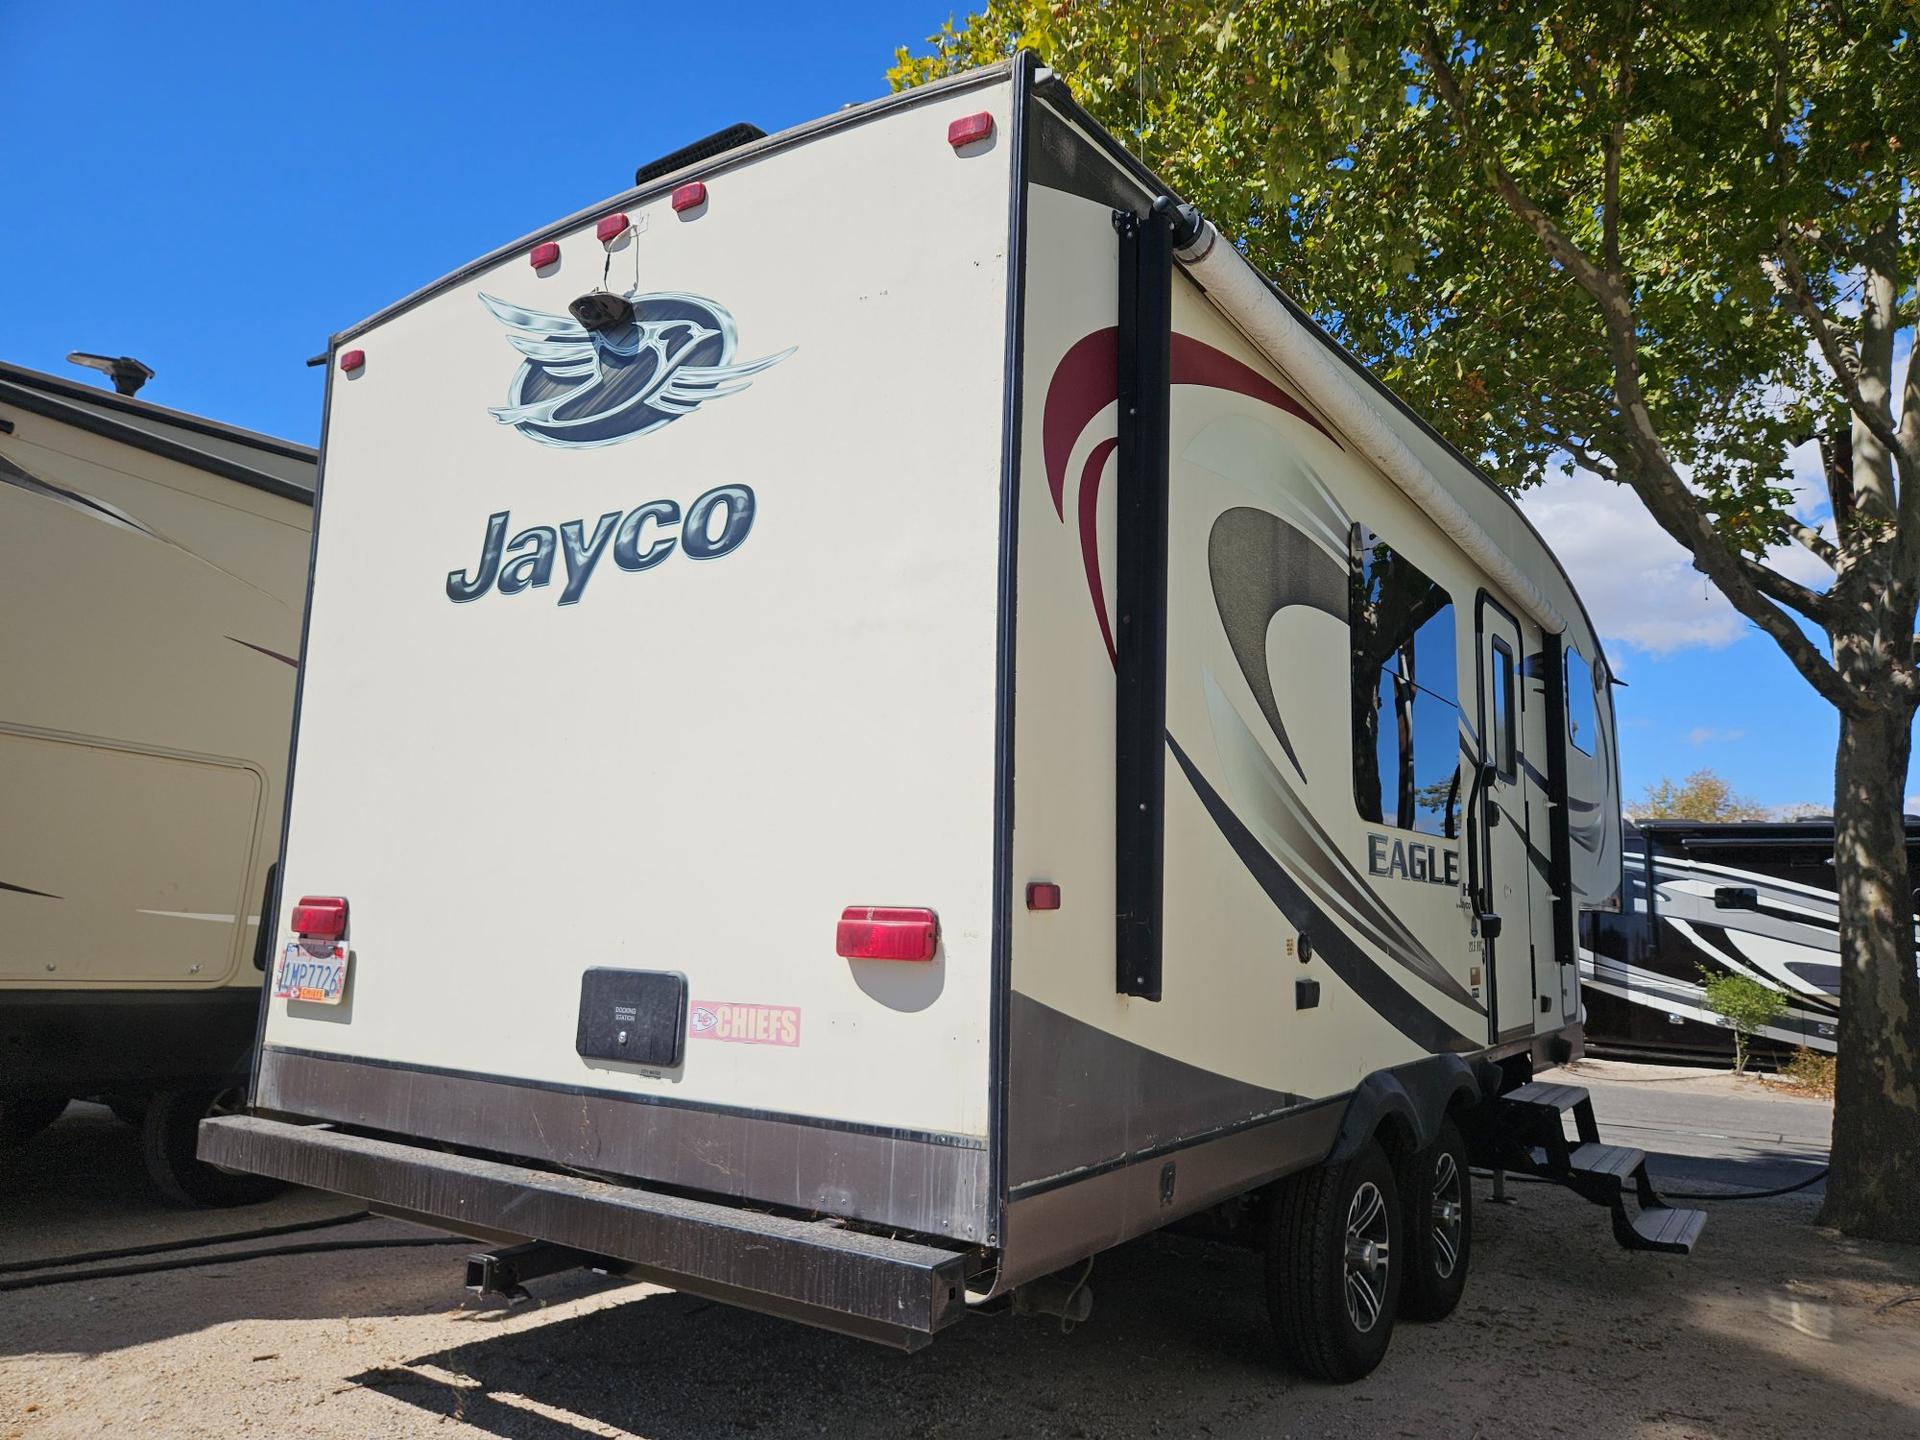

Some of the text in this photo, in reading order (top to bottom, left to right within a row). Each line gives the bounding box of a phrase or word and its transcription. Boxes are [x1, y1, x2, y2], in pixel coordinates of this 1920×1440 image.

[446, 483, 756, 606] Jayco
[1367, 832, 1459, 887] EAGLE
[281, 963, 340, 994] 1MP7726
[615, 1014, 635, 1022] STATION
[716, 1005, 797, 1043] CHIEFS
